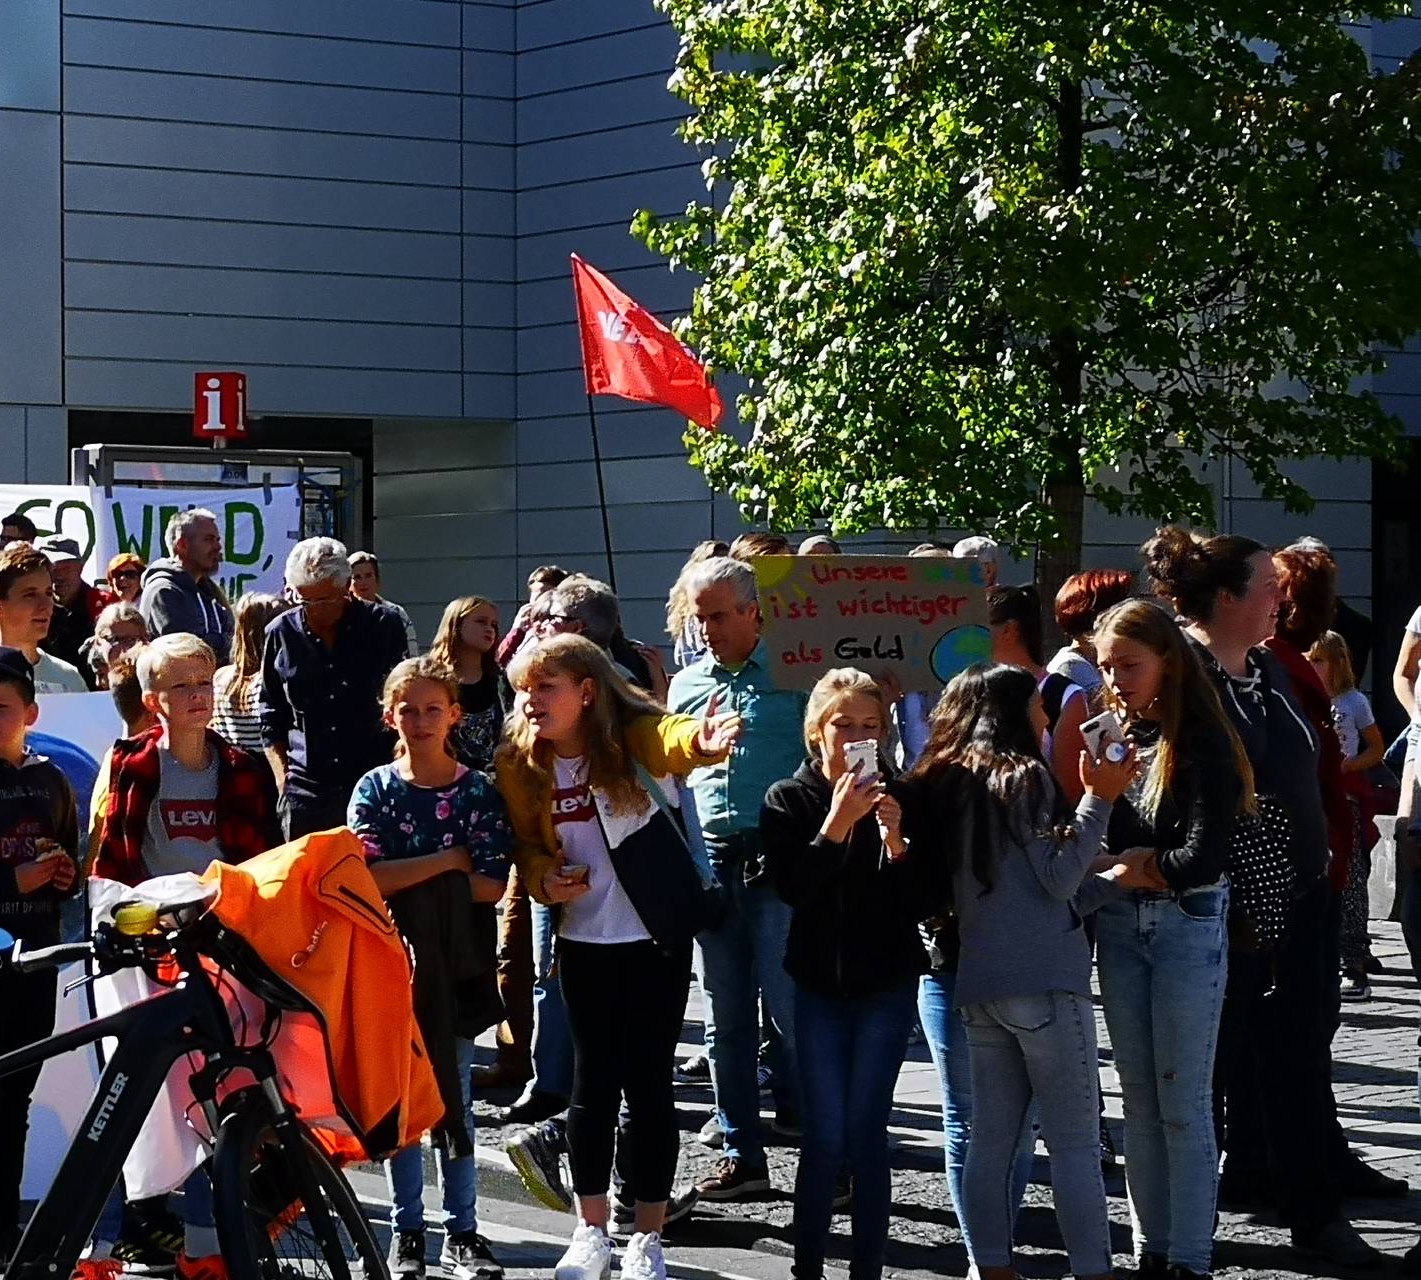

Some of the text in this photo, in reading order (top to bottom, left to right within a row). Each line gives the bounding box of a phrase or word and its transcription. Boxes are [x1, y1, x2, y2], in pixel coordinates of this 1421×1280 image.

[202, 377, 227, 430] i
[112, 500, 273, 572] WID,
[810, 562, 909, 585] Unsere
[770, 588, 970, 625] ist wichtiger
[781, 641, 823, 665] als
[833, 633, 904, 661] Geld
[87, 1072, 129, 1142] KETTLER
